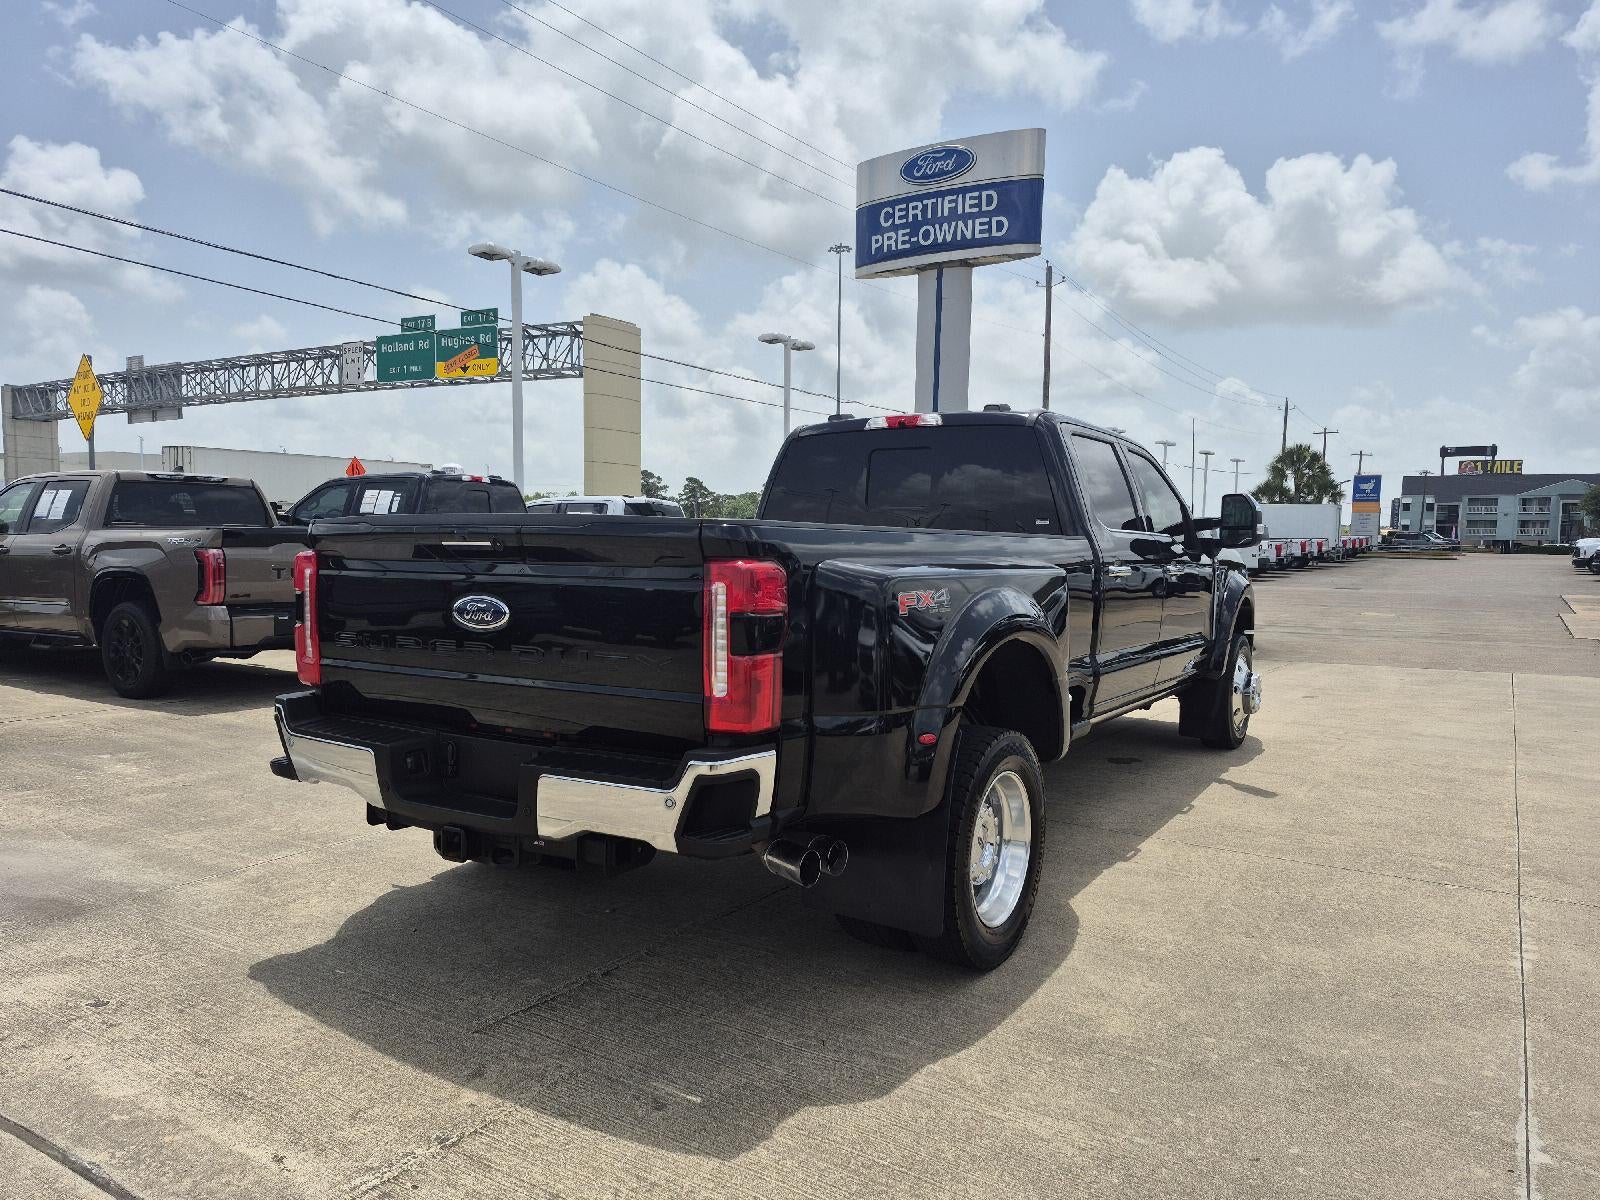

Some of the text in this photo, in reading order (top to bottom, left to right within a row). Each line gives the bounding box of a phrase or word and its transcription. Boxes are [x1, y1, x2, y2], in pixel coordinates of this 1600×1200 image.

[913, 151, 958, 178] Ford
[879, 189, 999, 228] CERTIFIED
[871, 215, 1009, 255] PRE-OWNED
[343, 346, 363, 355] SPEED
[381, 339, 430, 353] Holland Rd
[441, 332, 492, 349] Hughes Rd
[389, 366, 401, 374] EXIT
[471, 363, 491, 372] ONLY
[463, 602, 495, 622] Ford
[897, 588, 951, 617] FX4
[334, 630, 496, 657] SUPER
